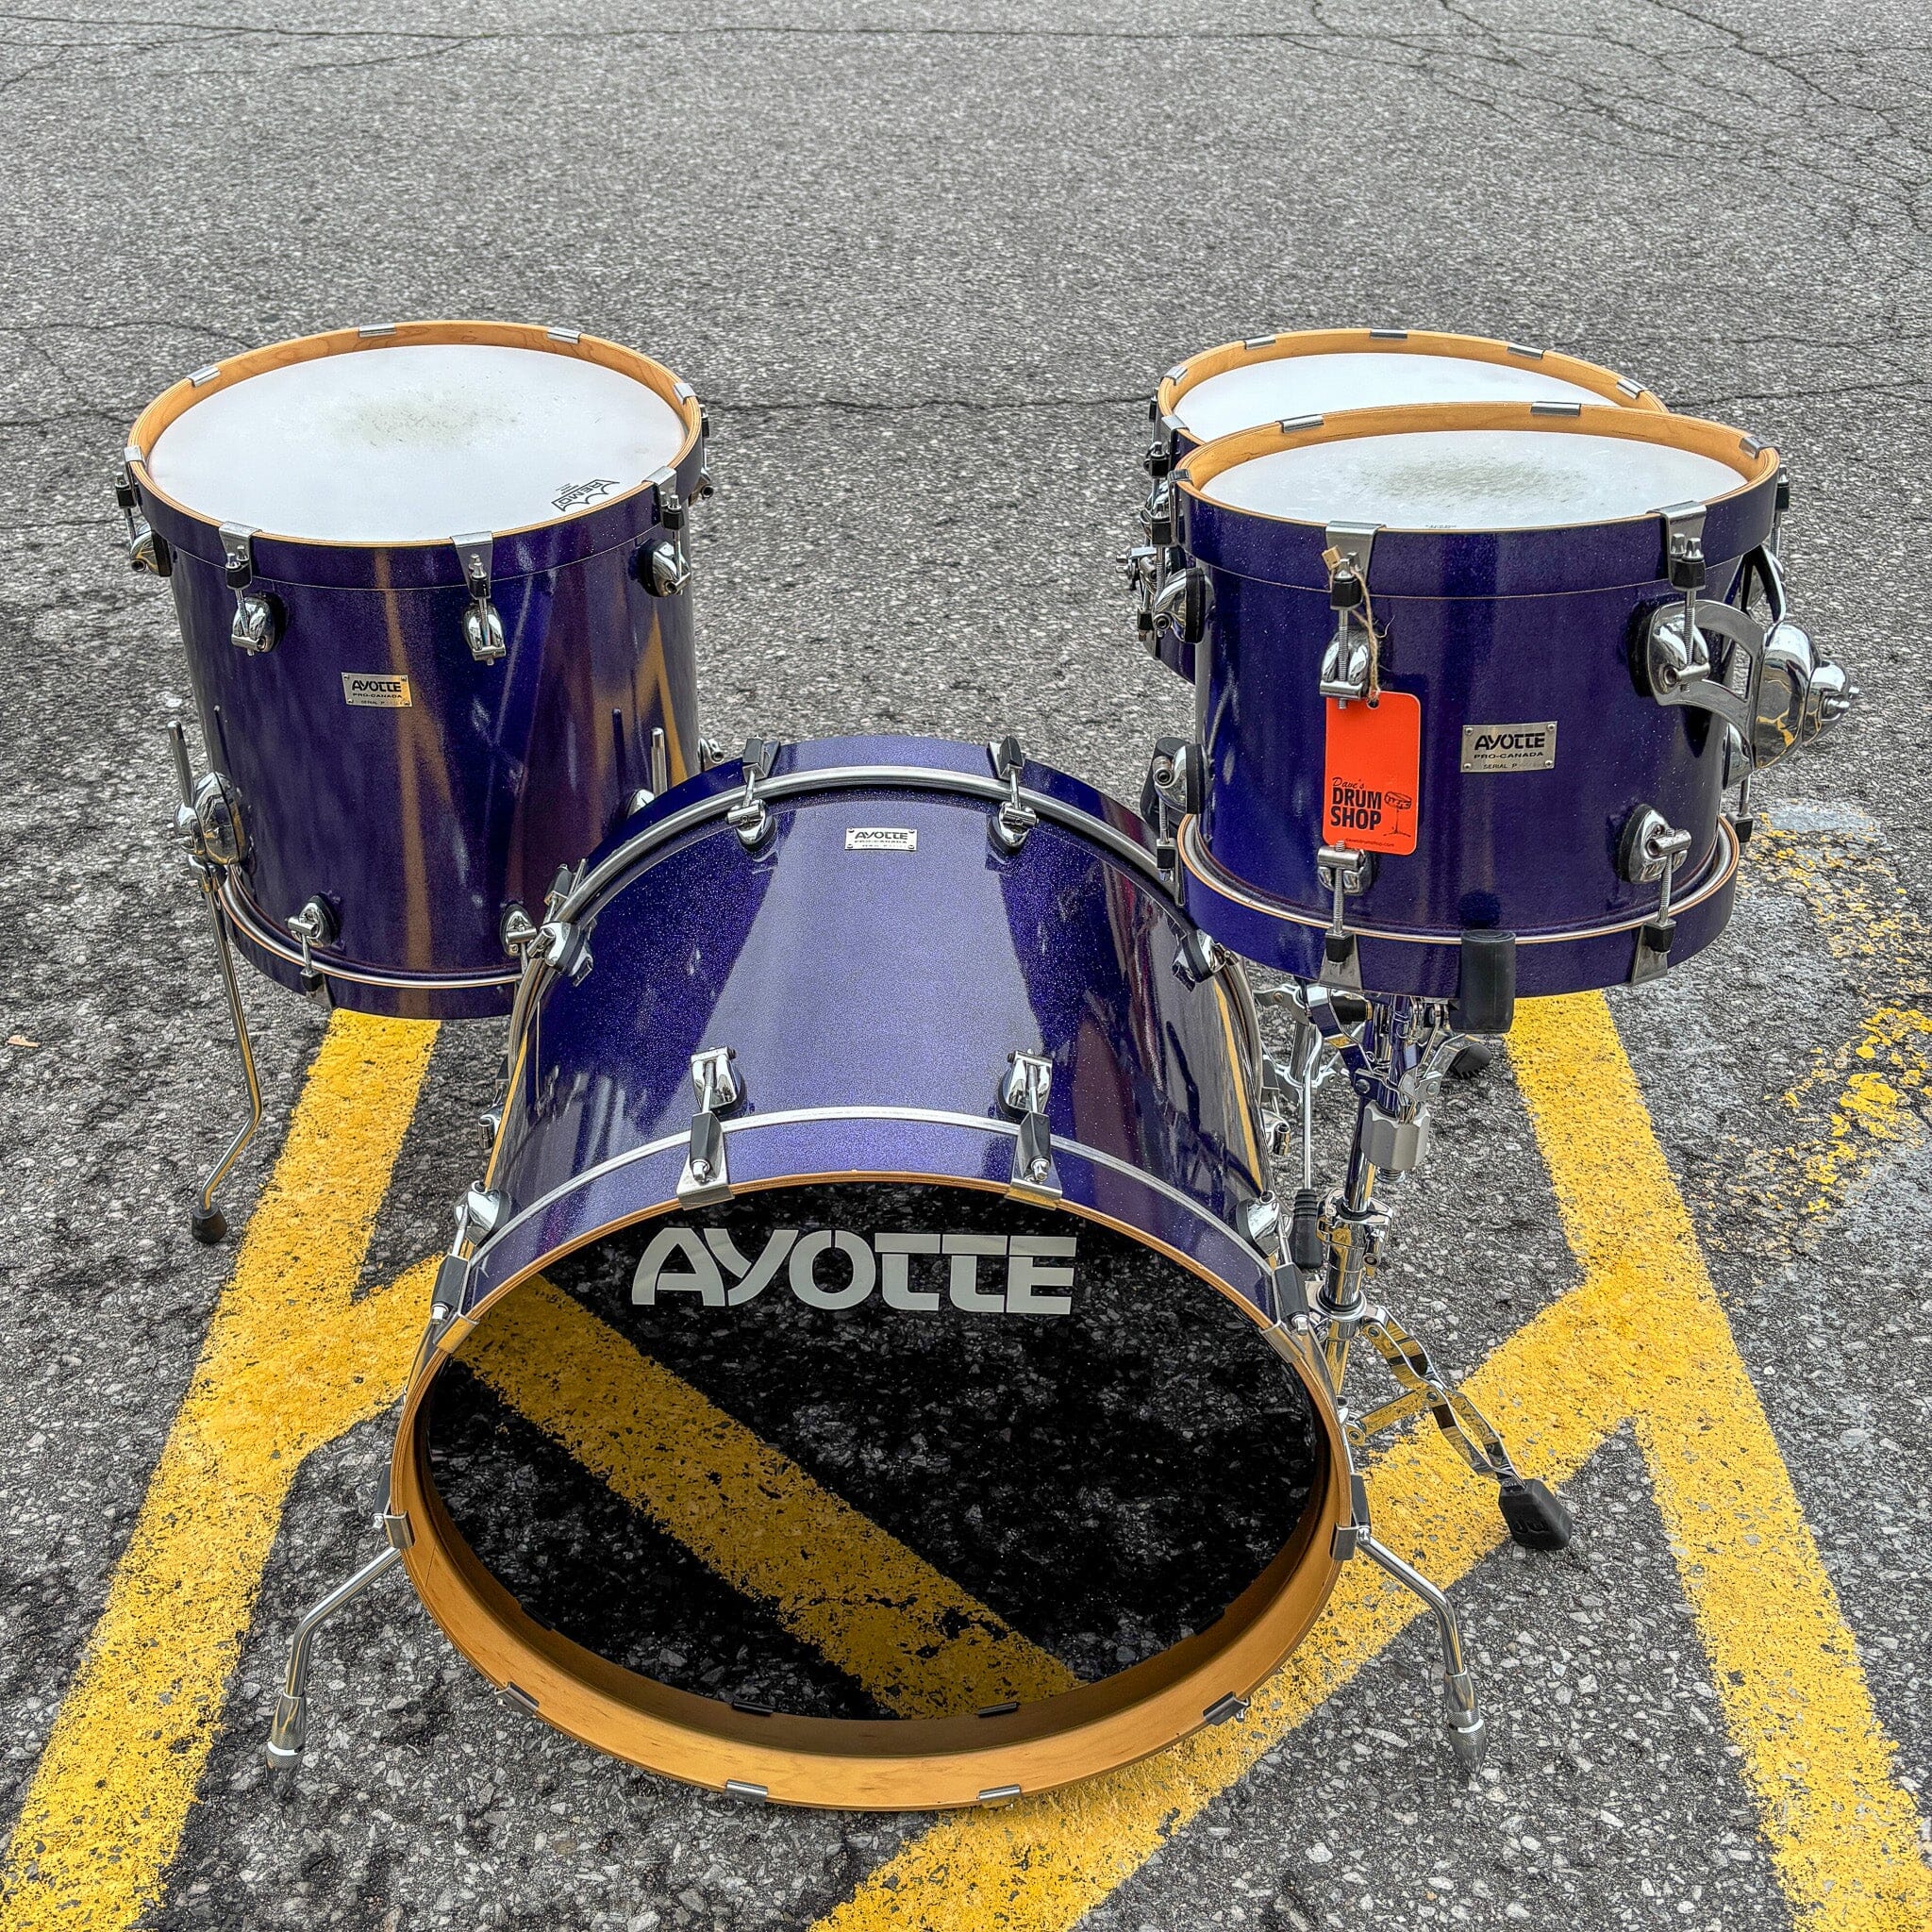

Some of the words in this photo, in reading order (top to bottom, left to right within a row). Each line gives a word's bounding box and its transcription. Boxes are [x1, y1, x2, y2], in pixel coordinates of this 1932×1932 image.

[558, 482, 603, 504] REMO
[352, 680, 401, 691] AYOTTE
[1474, 732, 1545, 750] AYOTTE
[1332, 776, 1364, 790] Dave's
[1332, 788, 1382, 810] DRUM
[1330, 806, 1381, 830] SHOP
[632, 1227, 1077, 1315] AYOTTE
